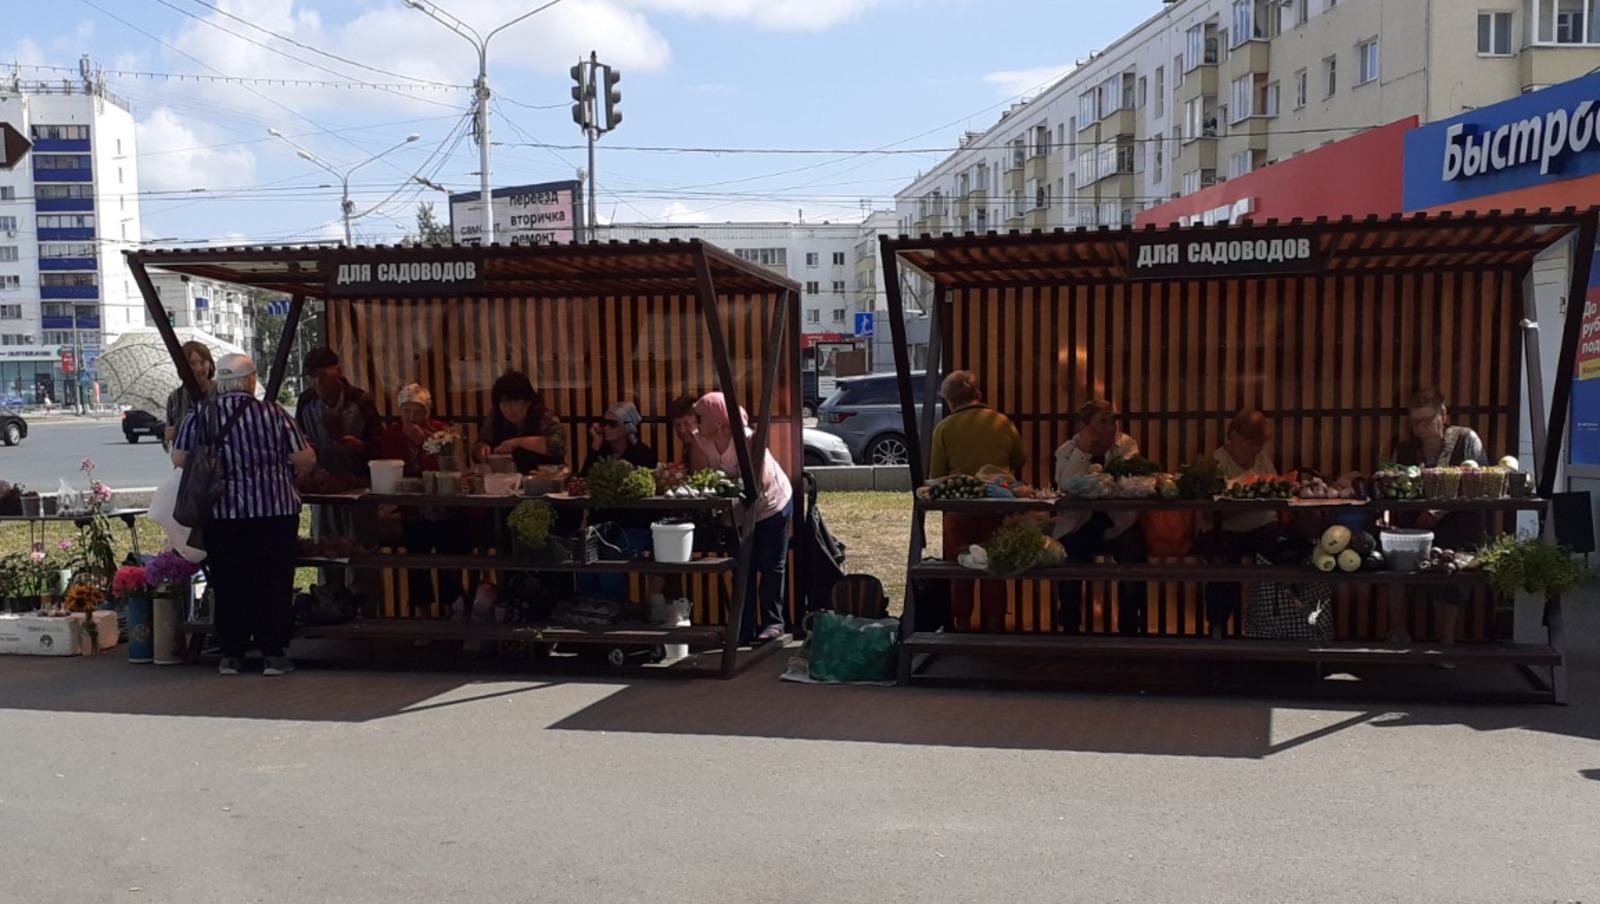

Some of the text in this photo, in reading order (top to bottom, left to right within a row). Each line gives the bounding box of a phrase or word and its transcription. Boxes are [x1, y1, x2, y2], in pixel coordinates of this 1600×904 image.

[1442, 100, 1600, 181] Быстро
[509, 190, 560, 209] переезд
[510, 211, 565, 227] вторичка
[460, 223, 501, 236] самт
[511, 232, 556, 246] ремонт
[1137, 238, 1311, 268] ДЛЯ САДОВОДОВ
[337, 261, 477, 285] ДЛЯ САДОВОДОВ
[1583, 301, 1597, 319] До
